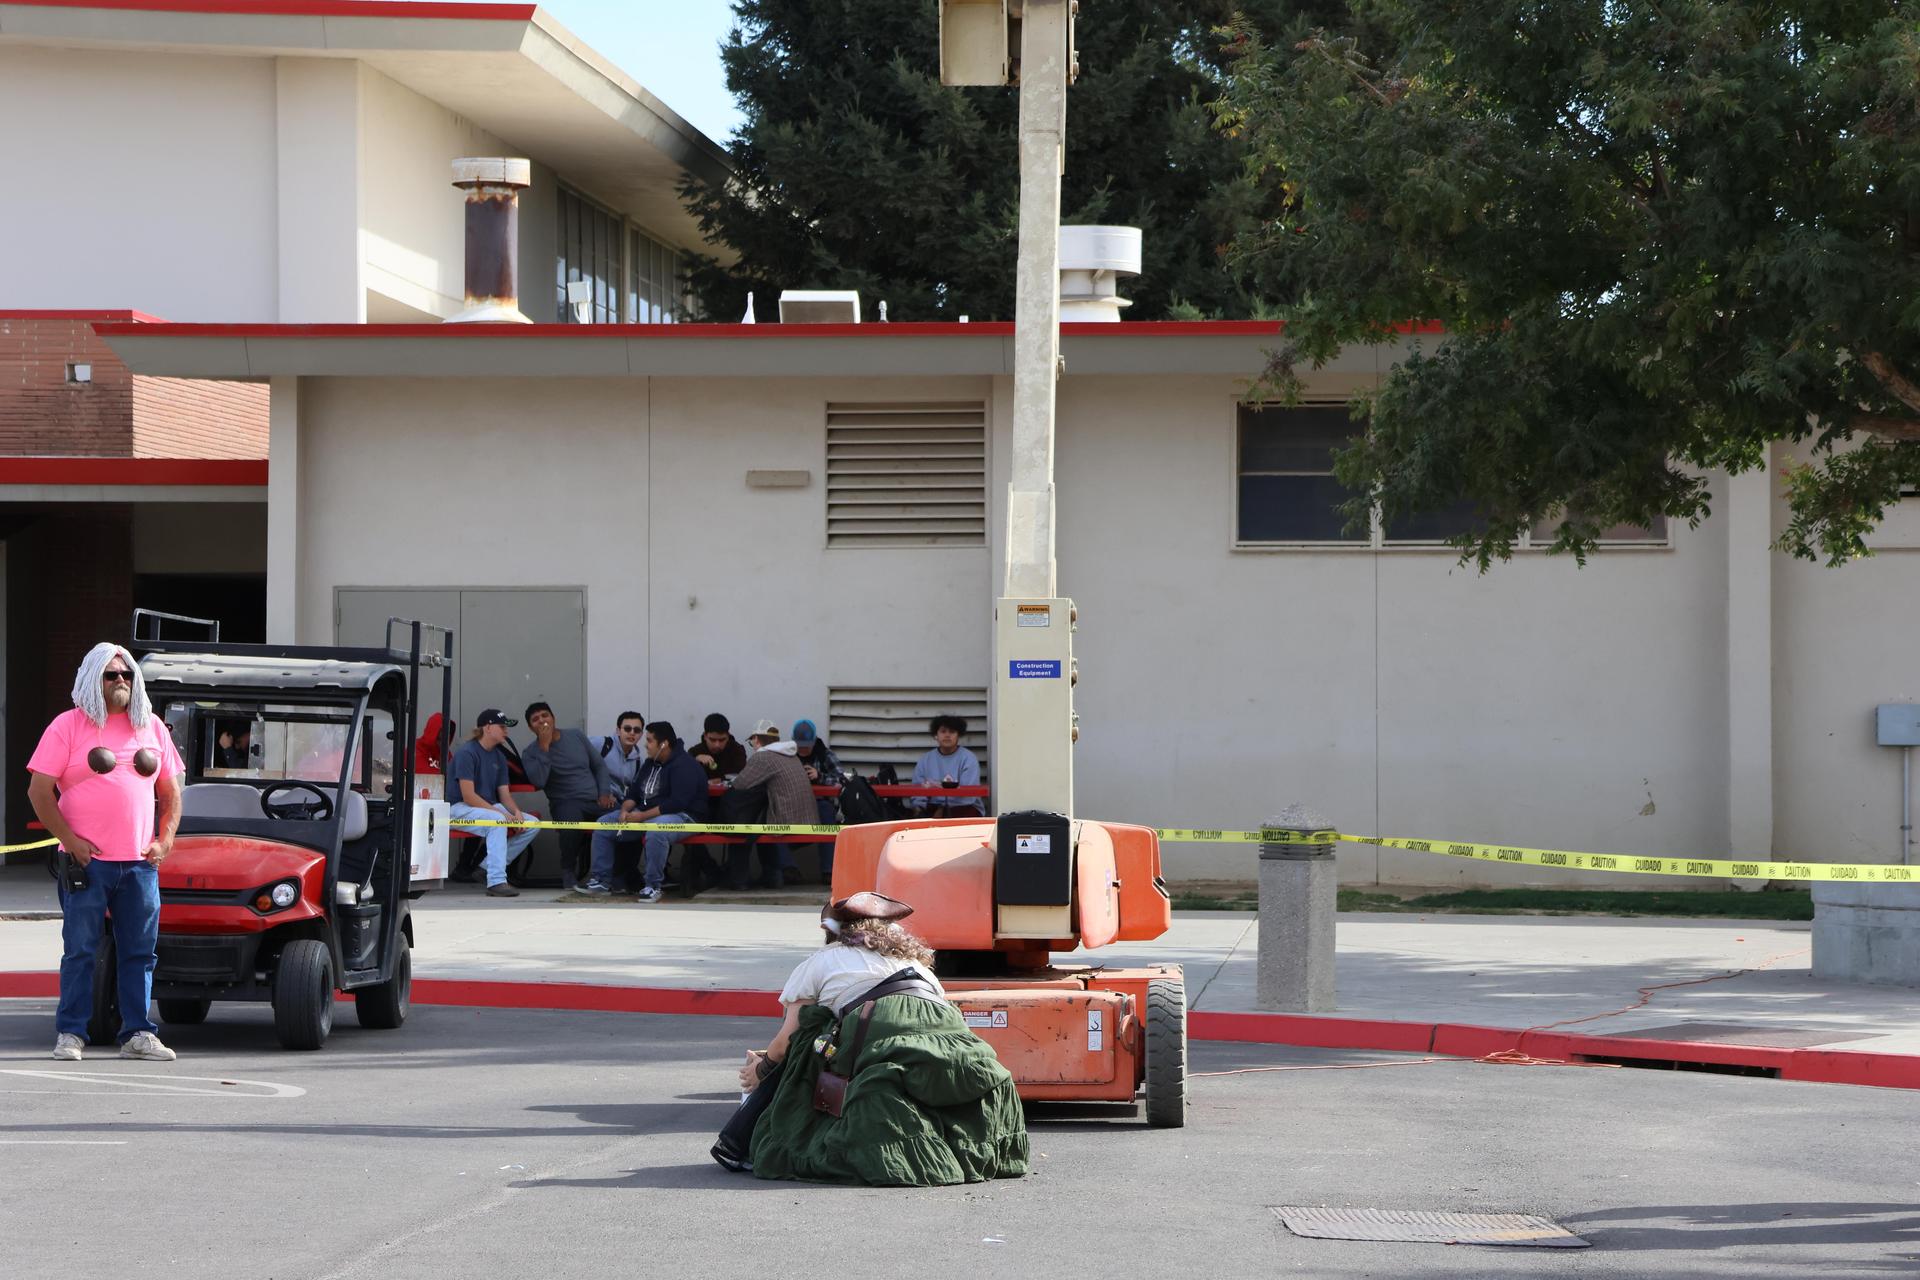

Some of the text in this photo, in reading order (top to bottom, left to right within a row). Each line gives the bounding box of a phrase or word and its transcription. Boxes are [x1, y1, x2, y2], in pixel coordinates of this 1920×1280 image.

[1405, 840, 1432, 852] CAUTION
[1447, 844, 1474, 857] CUIDADO
[1496, 848, 1523, 862] CAUTION
[1540, 852, 1567, 865] CUIDADO
[1590, 856, 1617, 869] CAUTION
[1635, 859, 1662, 872] CUIDADO
[1686, 862, 1713, 874] CAUTION
[1731, 864, 1759, 876] CUIDADO
[1784, 865, 1811, 878] CAUTION
[1830, 867, 1858, 879] CUIDADO
[1883, 868, 1911, 880] CAUTION
